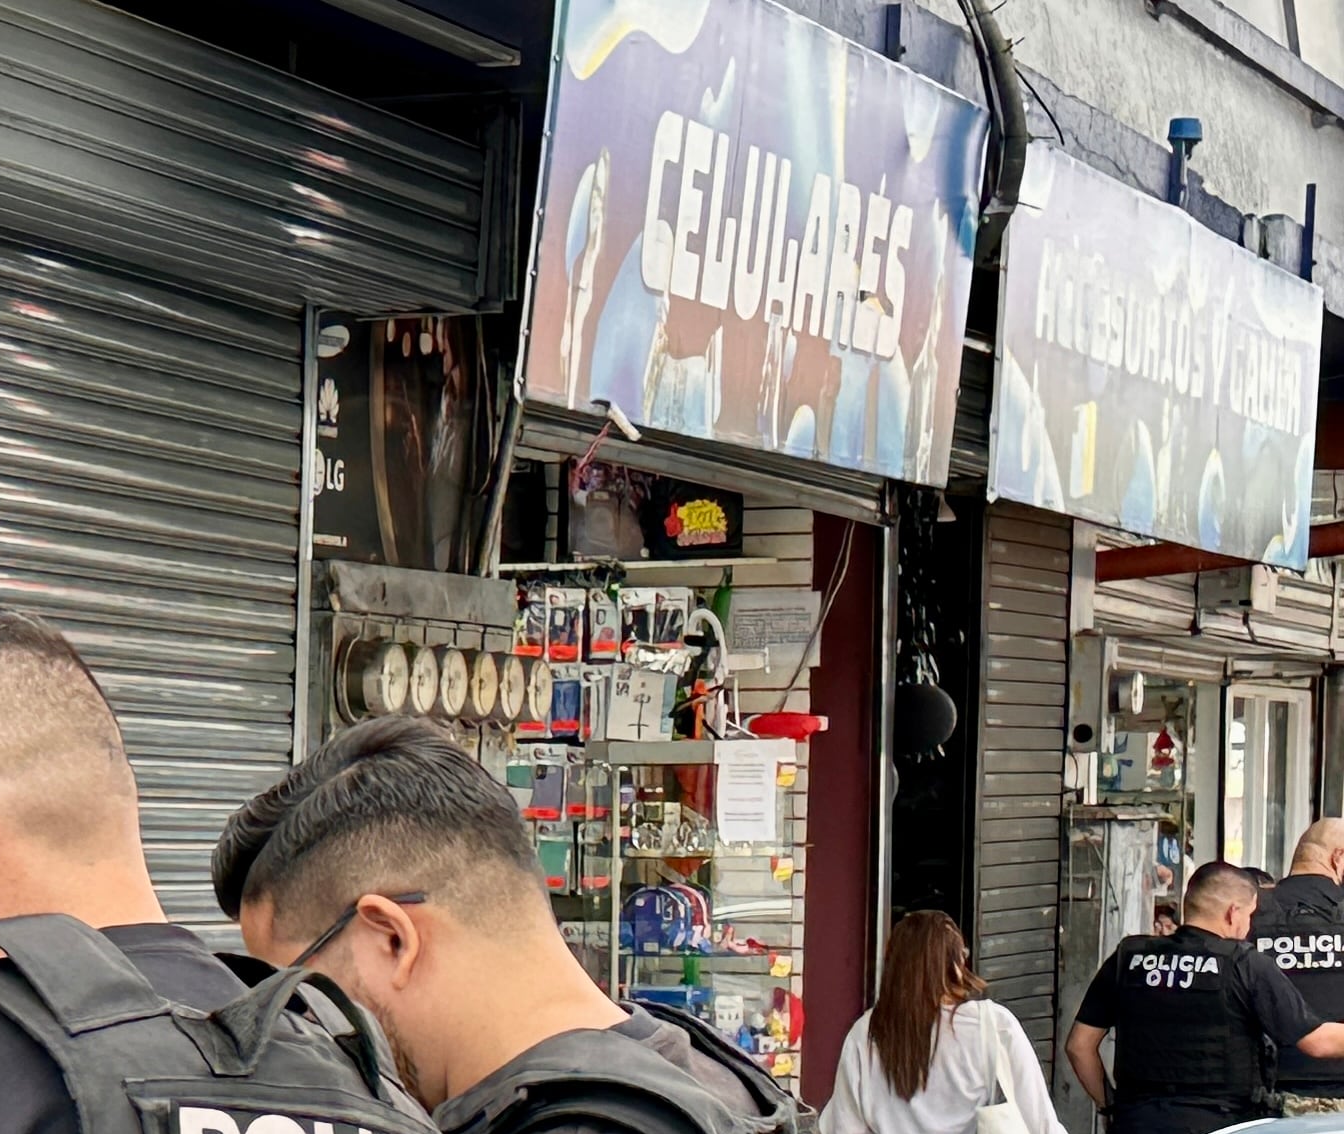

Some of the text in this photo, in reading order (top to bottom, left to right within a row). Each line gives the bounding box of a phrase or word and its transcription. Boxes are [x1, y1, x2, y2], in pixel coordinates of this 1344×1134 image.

[326, 458, 345, 492] LG
[1257, 934, 1344, 953] POLICI
[1129, 954, 1218, 974] POLICIA
